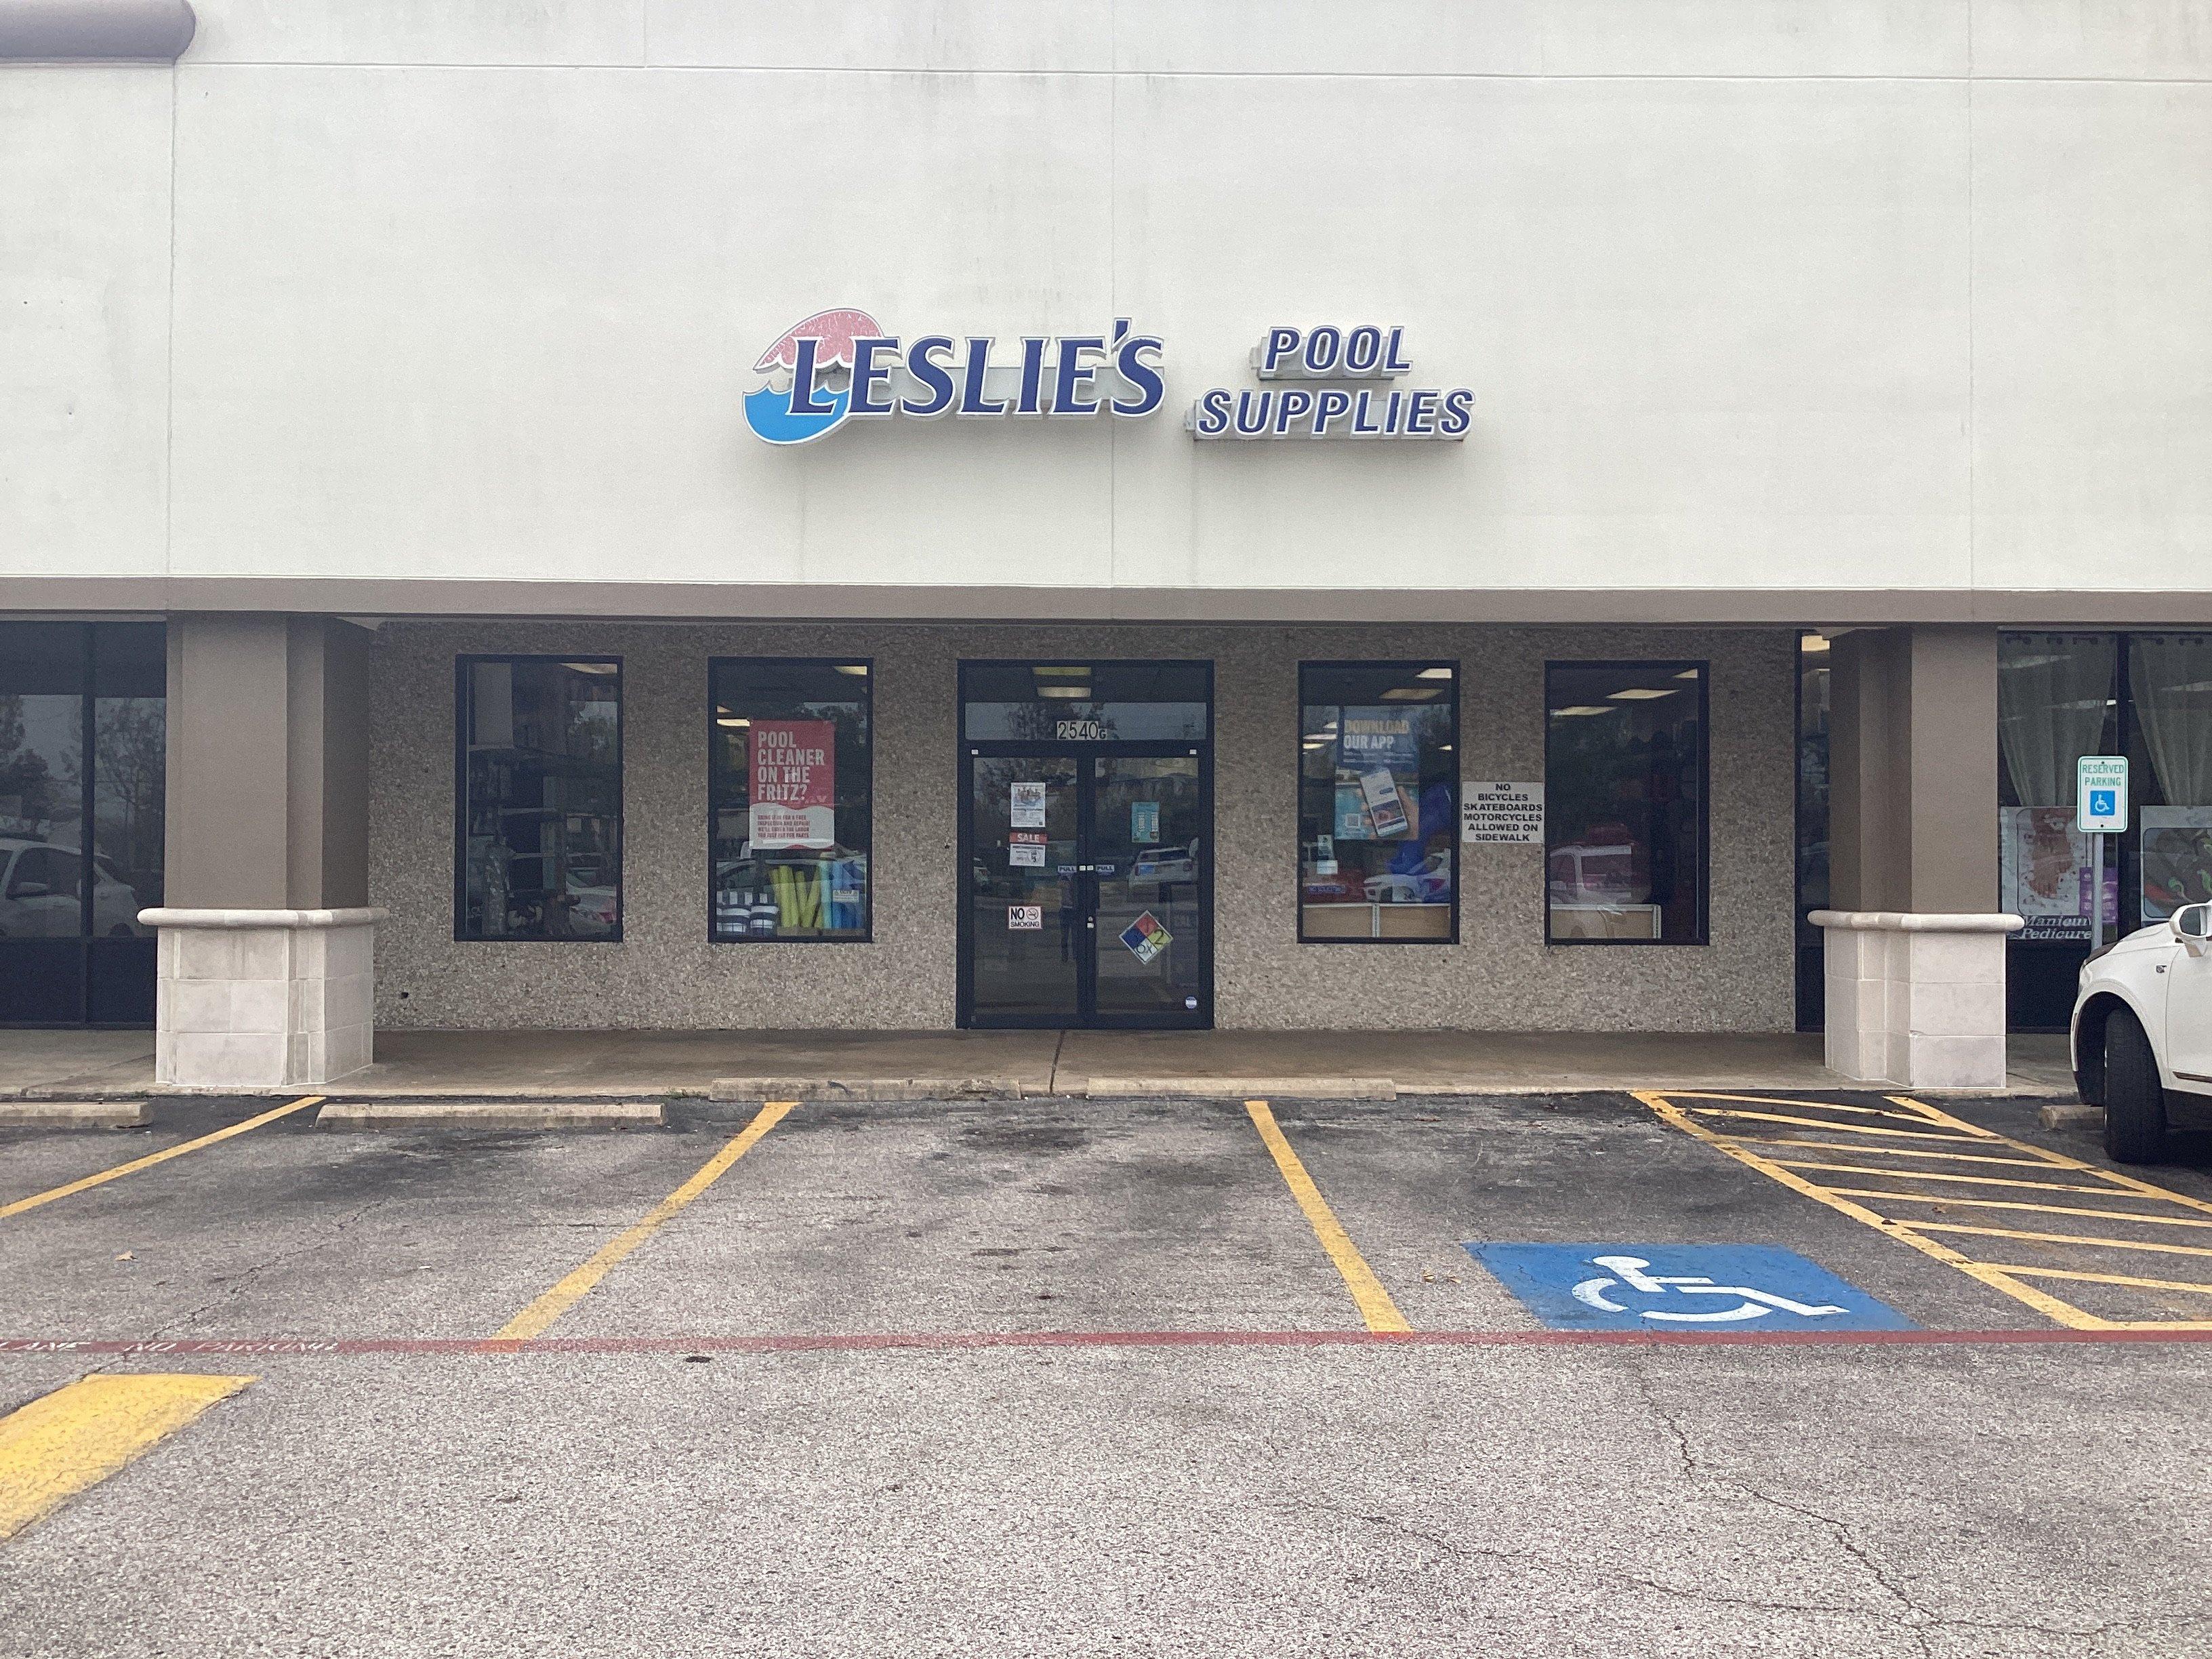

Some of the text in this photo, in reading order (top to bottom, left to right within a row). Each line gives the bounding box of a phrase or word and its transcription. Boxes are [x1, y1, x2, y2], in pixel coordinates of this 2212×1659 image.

[1261, 325, 1414, 373] POOL
[785, 318, 1165, 417] LESLIE'S
[1197, 388, 1476, 436] SUPPLIES
[758, 731, 797, 748] POOL
[1343, 735, 1394, 750] OUR APP
[758, 748, 825, 766] CLEANER
[758, 766, 811, 783] ON THE
[2082, 764, 2124, 774] RESERVED
[2085, 777, 2121, 786] PARKING
[758, 783, 808, 801] FRITZ?
[1477, 793, 1529, 801] BICYCLES
[1463, 802, 1542, 811] SKATEBOARDS
[1463, 813, 1542, 821] MOTORCYCLES
[1468, 823, 1538, 832] ALLOWED ON
[1017, 833, 1040, 843] SALE
[1475, 833, 1530, 842] SIDEWALK
[1010, 907, 1025, 920] NO
[2024, 915, 2091, 926] Manicur
[1153, 928, 1164, 945] 2
[2020, 928, 2092, 939] Pedicure
